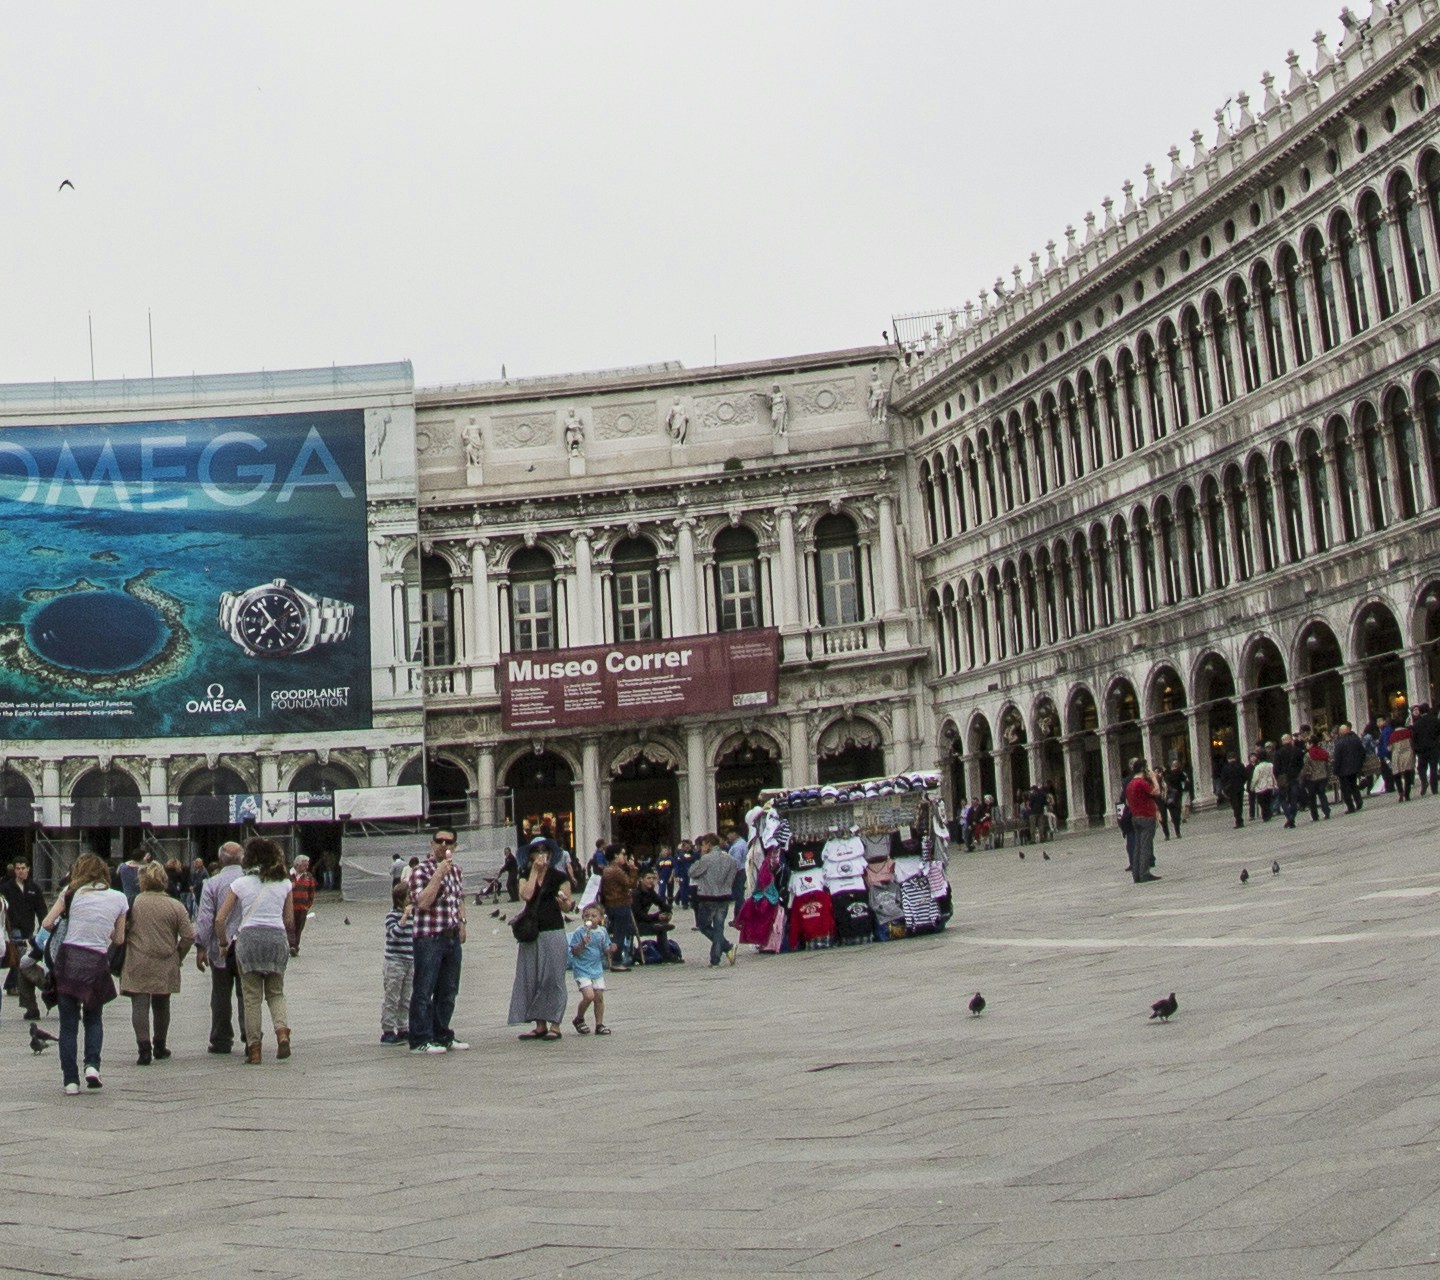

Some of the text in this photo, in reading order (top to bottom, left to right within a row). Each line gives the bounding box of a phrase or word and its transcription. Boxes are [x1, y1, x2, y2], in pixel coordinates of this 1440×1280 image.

[508, 649, 693, 682] Museo Correr
[270, 686, 350, 700] GOODPLANET
[39, 701, 55, 709] dual
[88, 700, 104, 708] GMT
[105, 700, 133, 708] function
[186, 699, 247, 713] OMEGA
[271, 697, 348, 710] FOUNDATION
